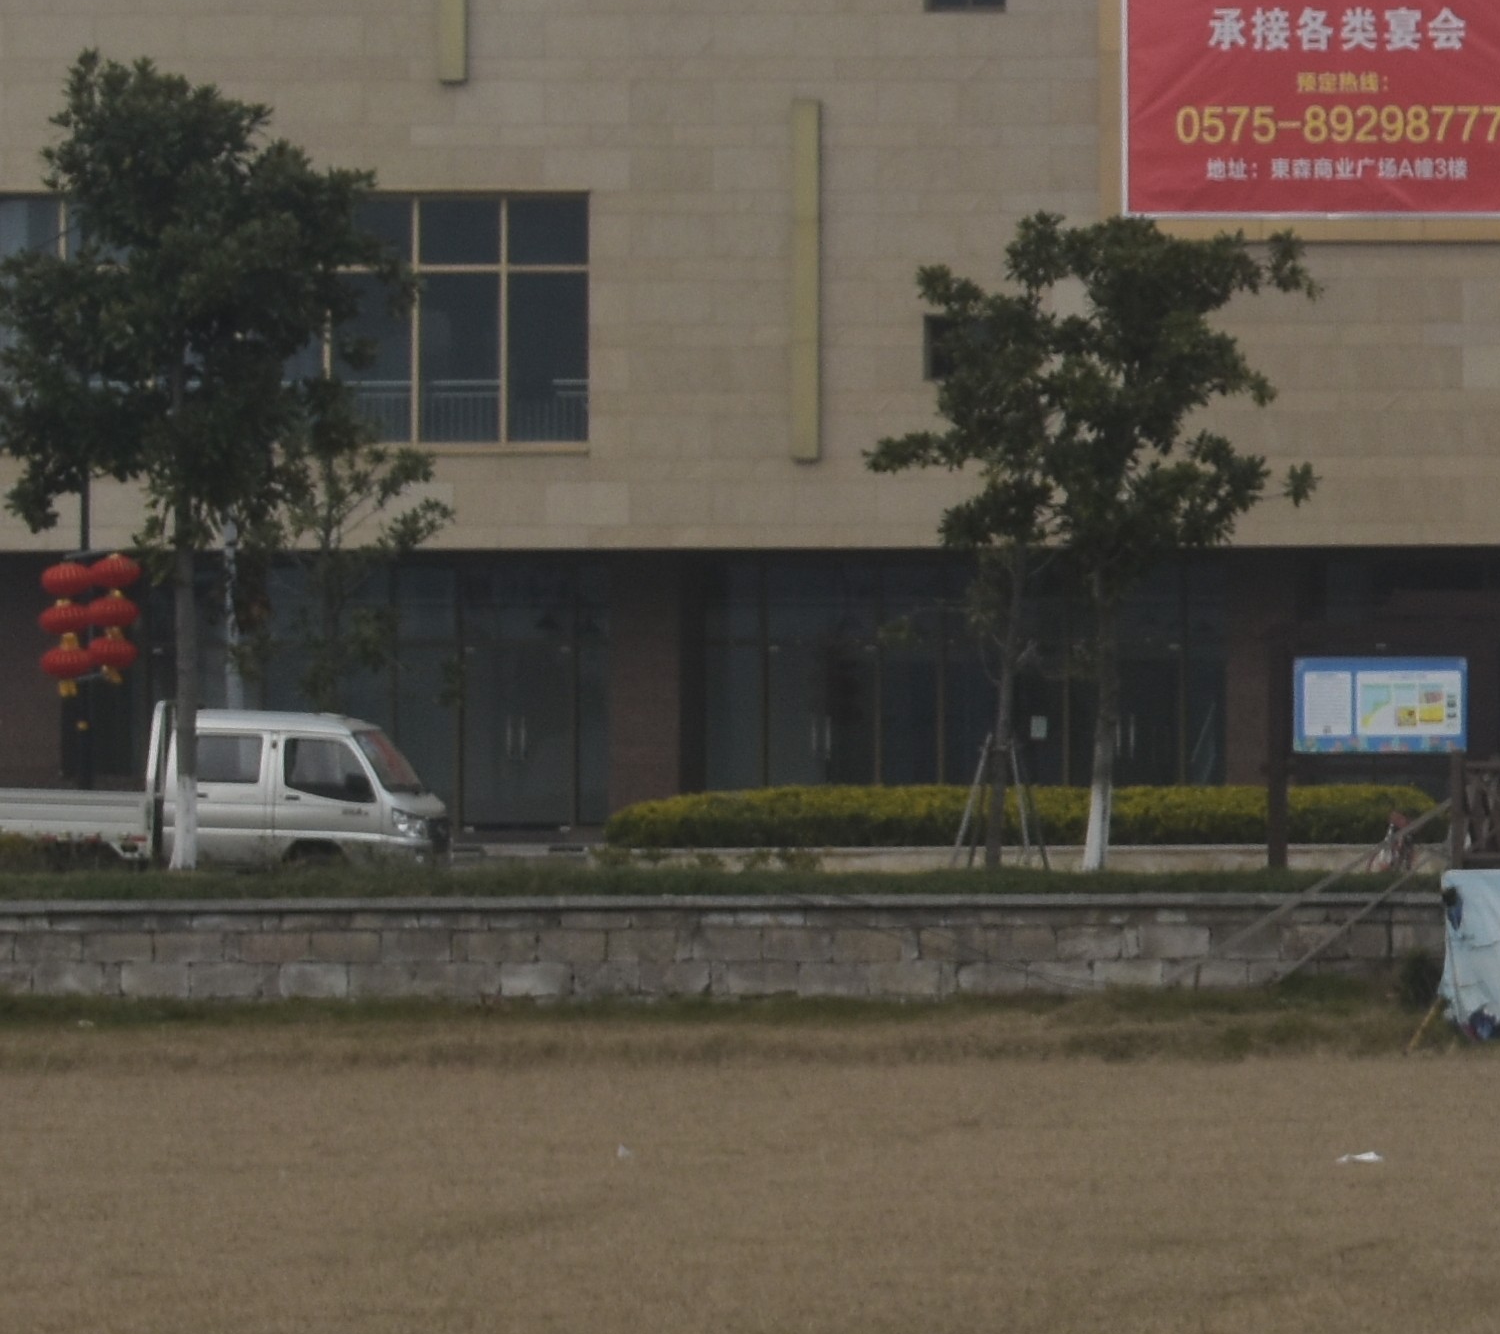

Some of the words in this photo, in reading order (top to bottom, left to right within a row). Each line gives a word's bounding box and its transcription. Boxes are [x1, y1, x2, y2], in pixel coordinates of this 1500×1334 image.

[1208, 6, 1467, 51] 承接各类宴会
